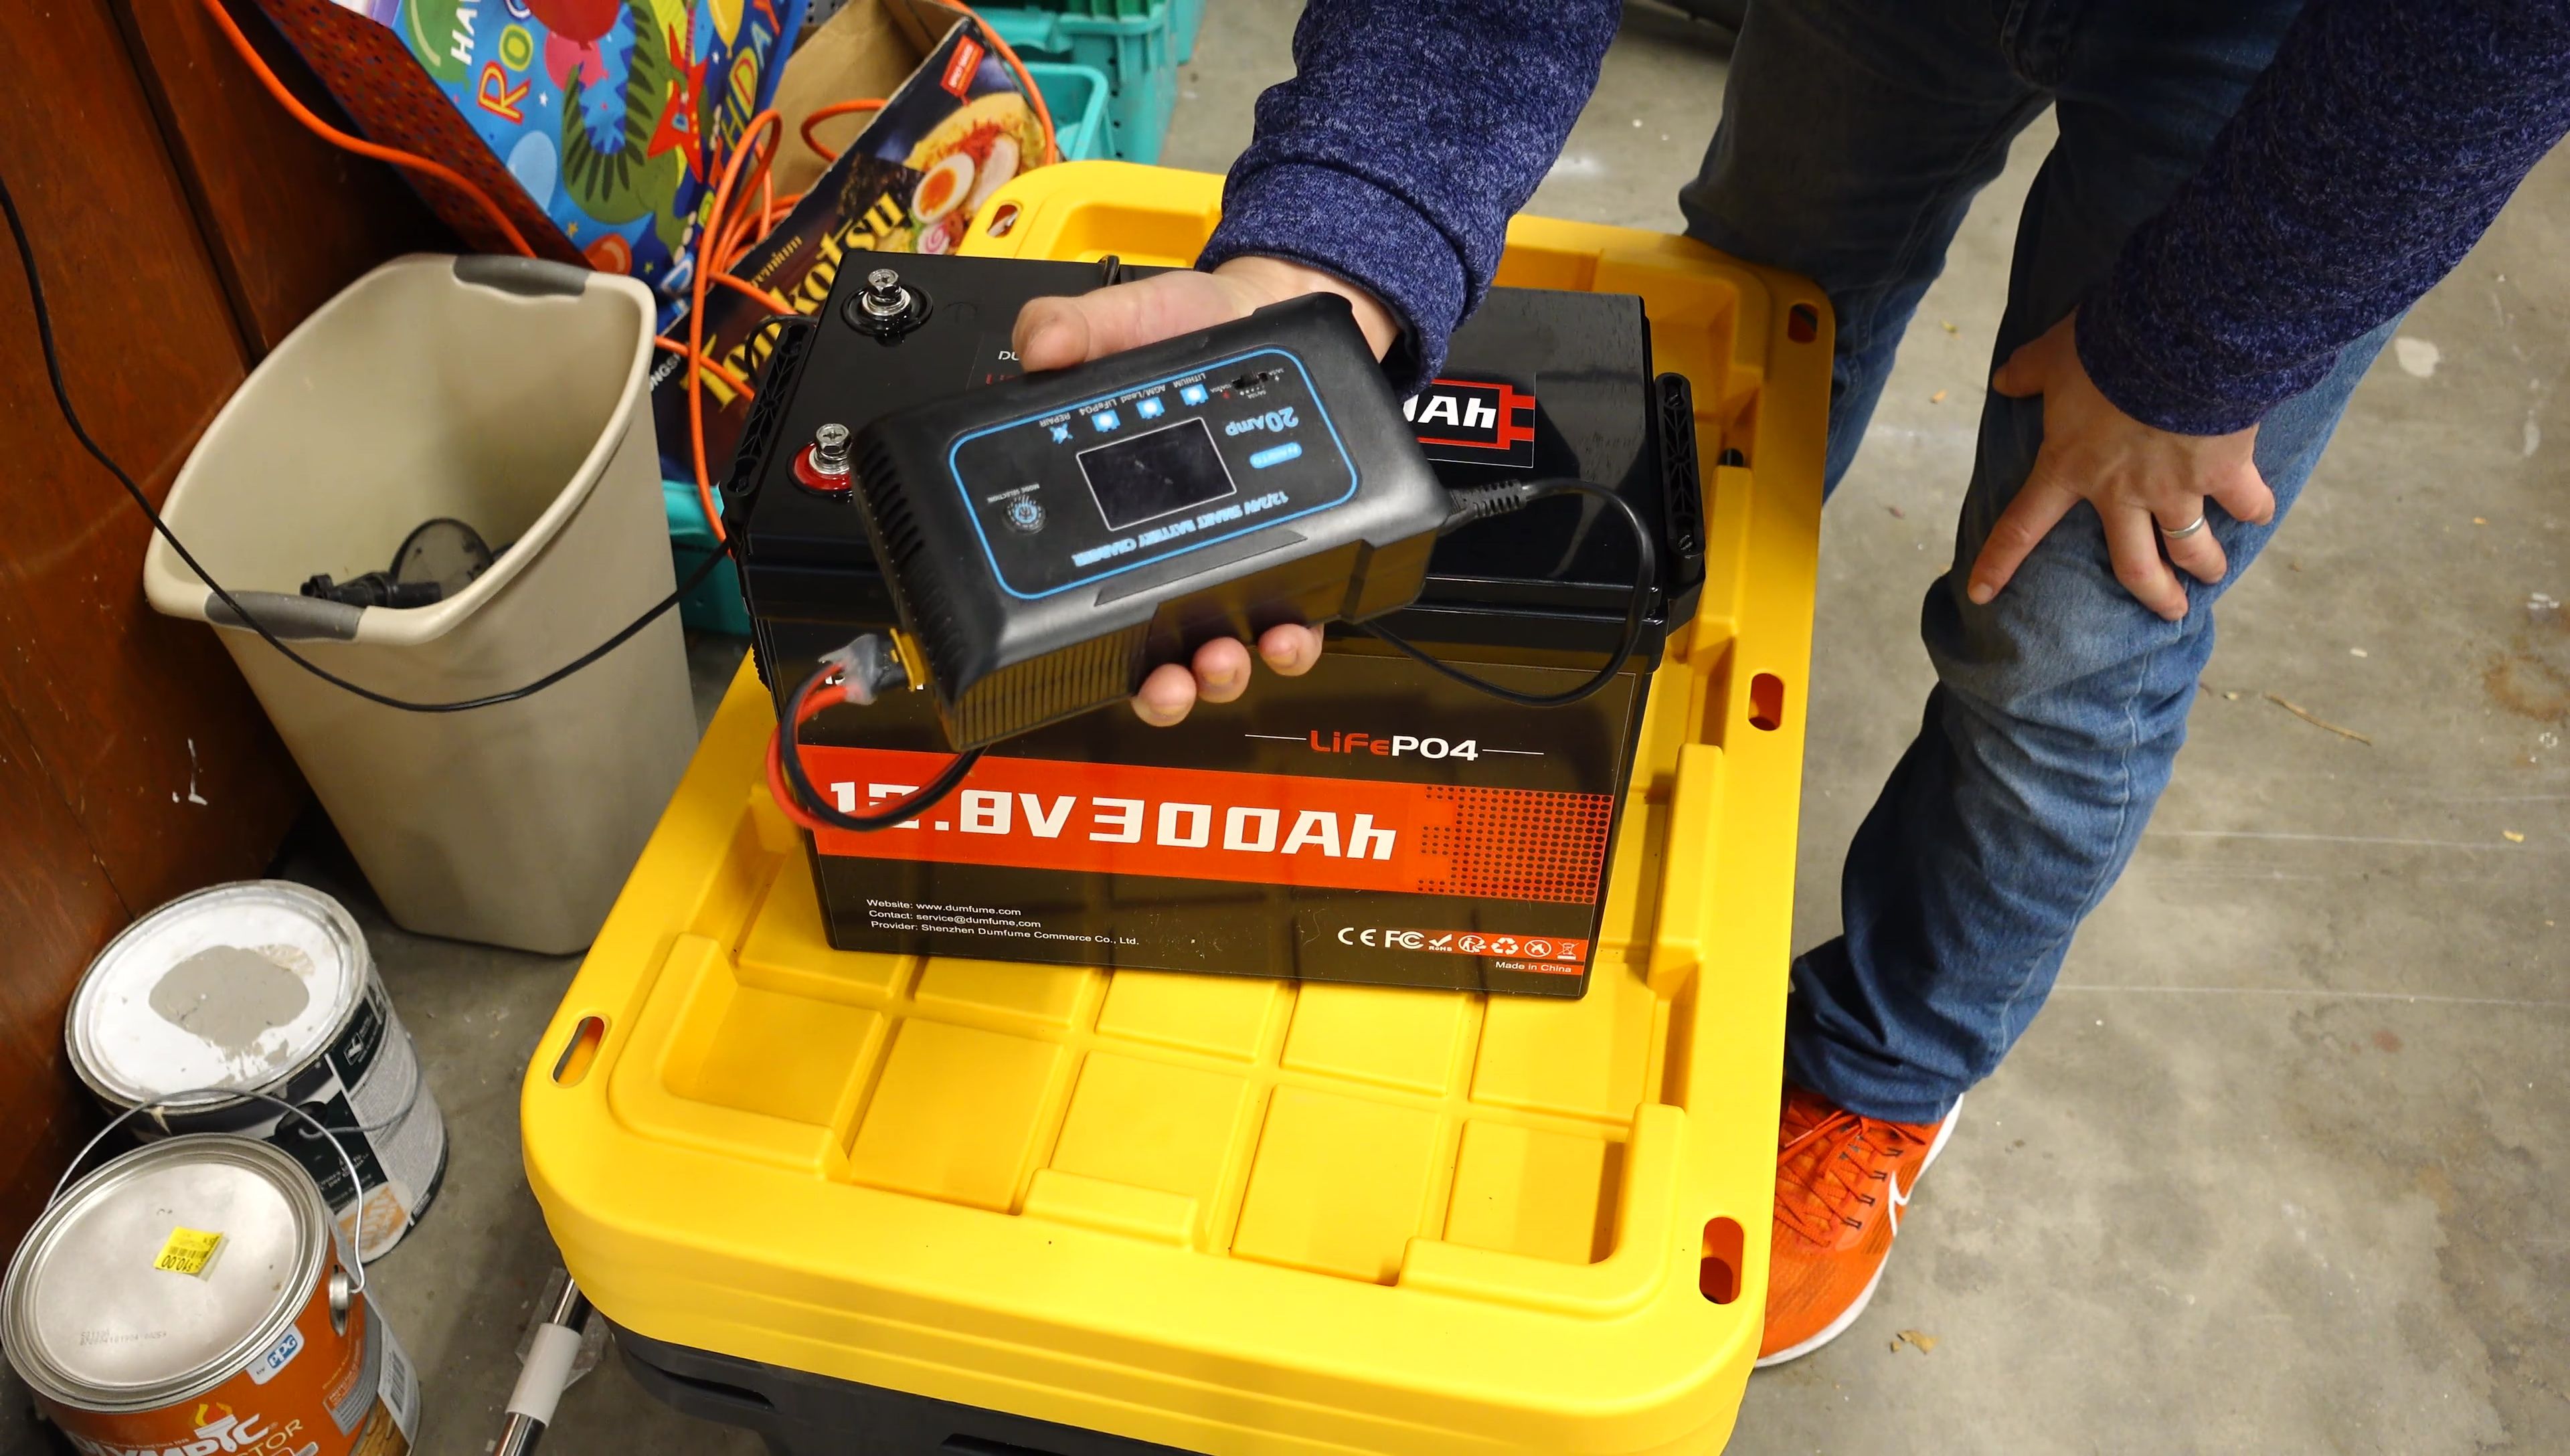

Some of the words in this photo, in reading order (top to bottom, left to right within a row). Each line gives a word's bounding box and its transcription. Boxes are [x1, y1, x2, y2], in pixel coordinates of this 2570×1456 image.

[751, 236, 803, 288] remium
[1173, 373, 1206, 388] LITHIUM
[1121, 384, 1166, 403] AGM/Lead
[1039, 413, 1071, 427] REPAIR
[1197, 505, 1244, 529] SMART
[1138, 519, 1197, 547] BATTERY
[1071, 538, 1137, 567] CHARGER
[1309, 730, 1478, 761] LiFePO4
[867, 899, 913, 909] Website:
[916, 903, 1022, 916] www.dumfume.com
[869, 910, 914, 919] Contact:
[916, 913, 1041, 928] service@dumfume.com
[871, 921, 918, 931] Provider:
[921, 924, 974, 935] Shenzhen
[978, 927, 1031, 938] Dumfume
[1033, 931, 1092, 942] Commerce
[1094, 935, 1116, 945] Co.,
[1119, 937, 1139, 945] Ltd.
[1496, 961, 1525, 970] Made
[1541, 964, 1572, 974] China
[268, 1336, 296, 1367] PPG
